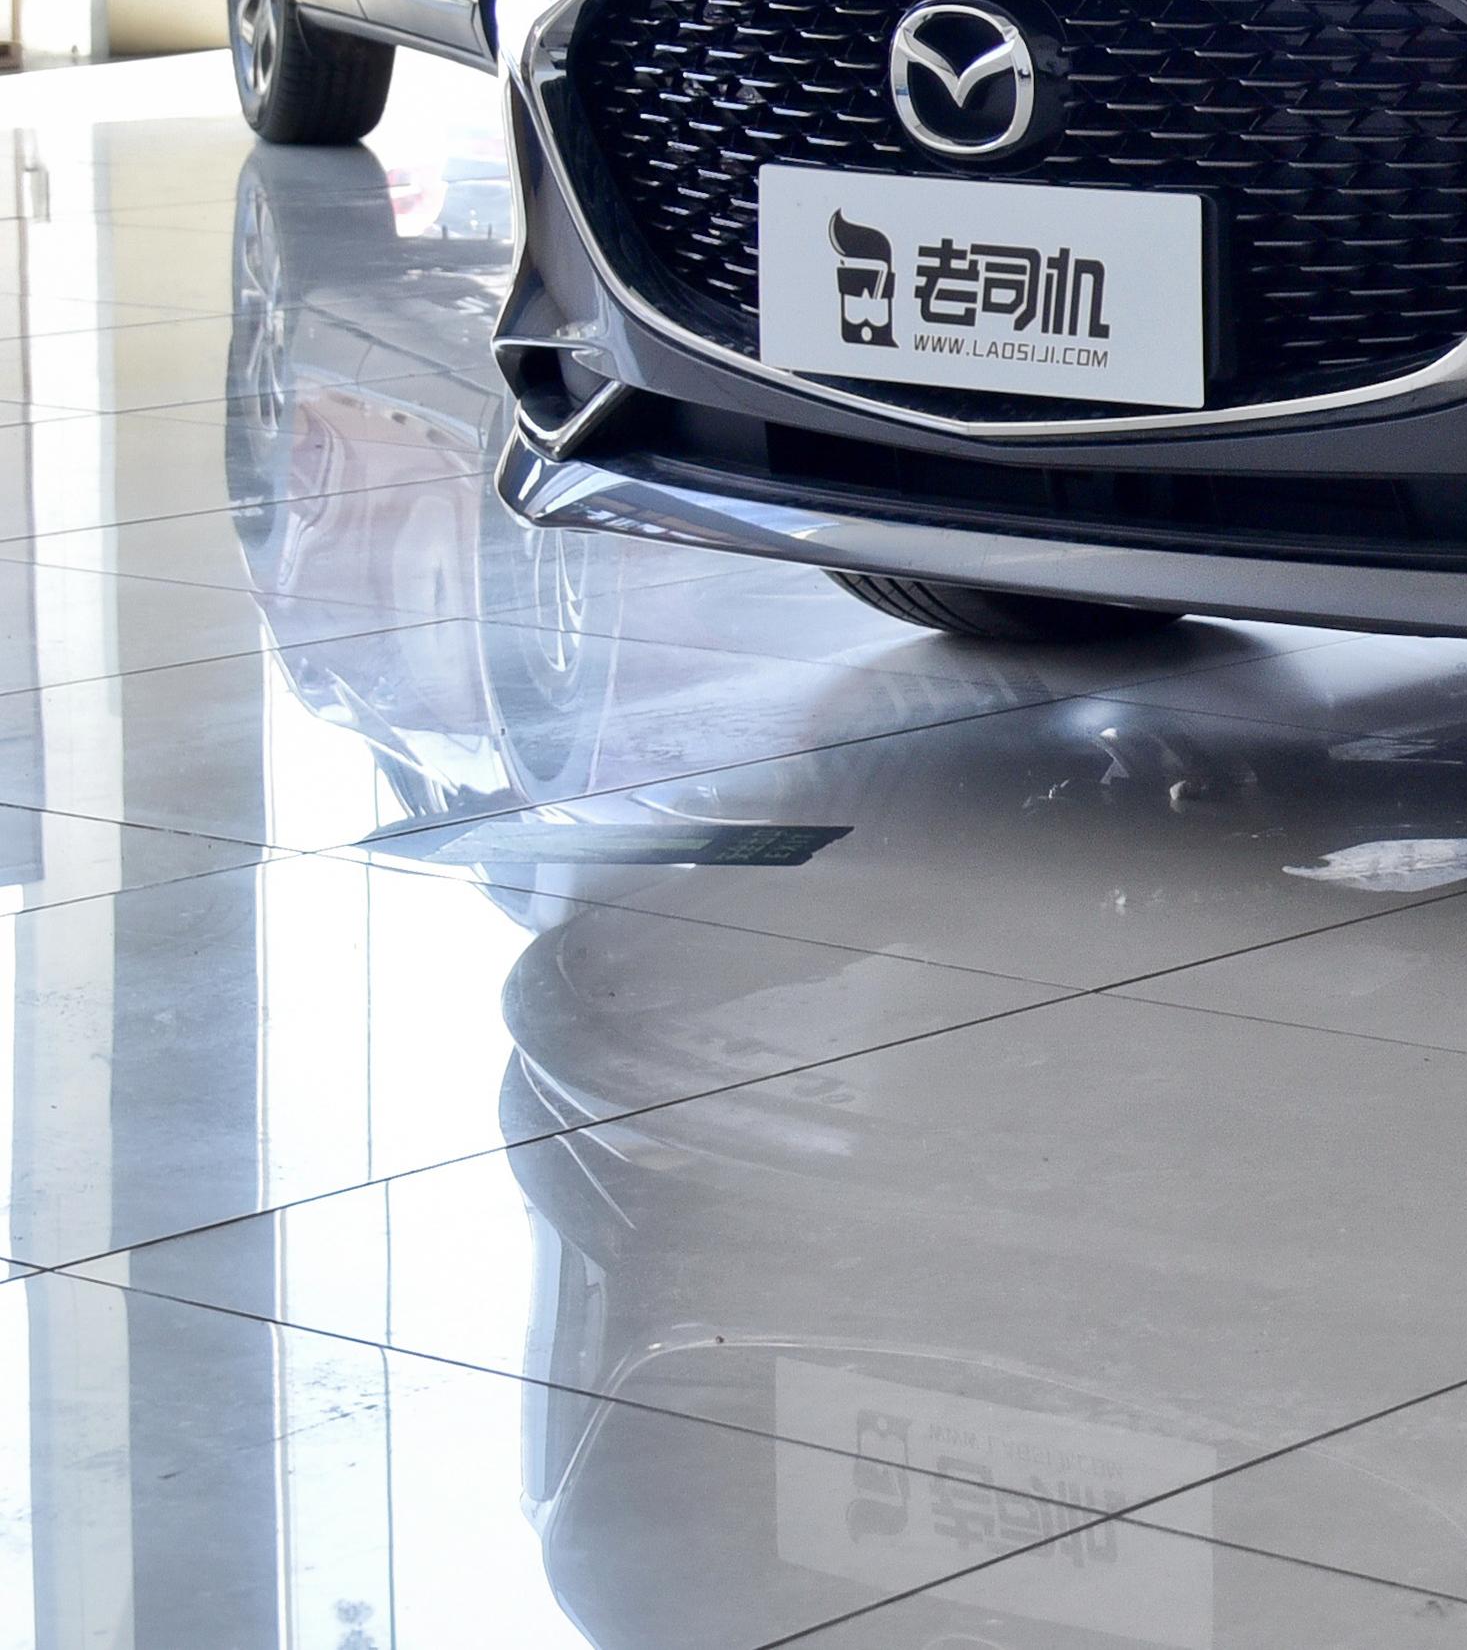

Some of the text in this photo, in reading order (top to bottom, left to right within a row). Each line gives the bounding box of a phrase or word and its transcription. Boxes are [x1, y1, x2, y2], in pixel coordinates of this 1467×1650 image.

[914, 238, 1110, 339] 老司机
[913, 333, 1109, 369] WWW.LAOSIJI.COM
